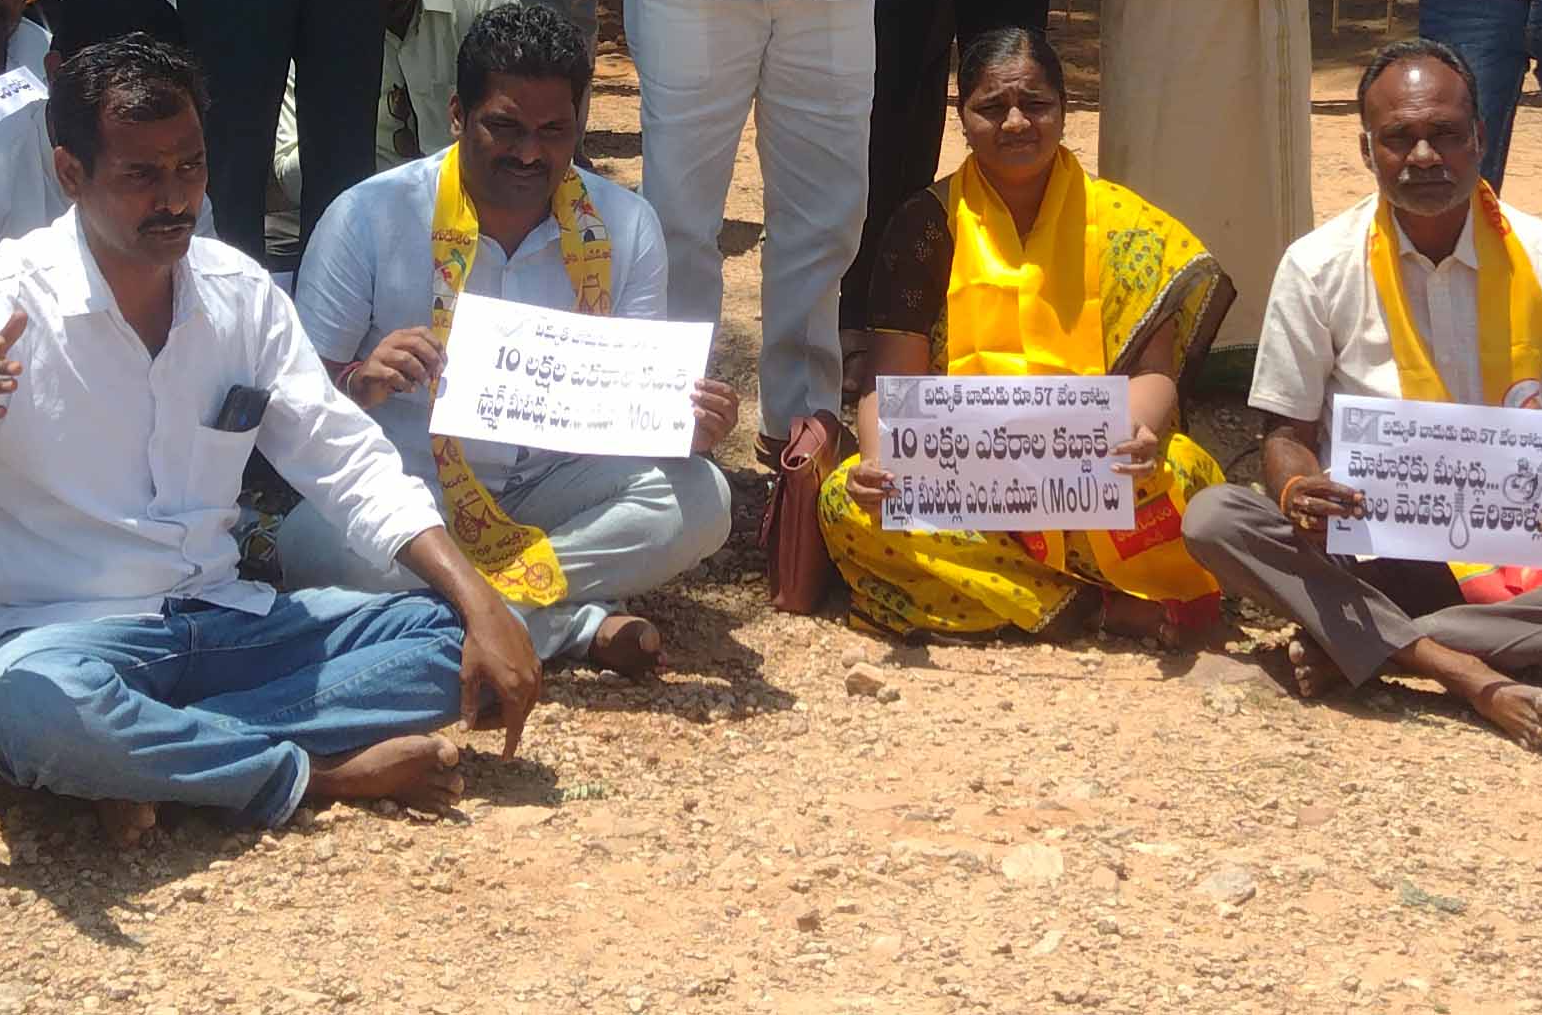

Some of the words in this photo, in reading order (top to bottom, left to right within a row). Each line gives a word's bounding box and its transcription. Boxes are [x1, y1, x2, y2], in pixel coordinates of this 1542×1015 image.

[495, 346, 521, 371] 10
[924, 384, 962, 412] విద్యుత్
[1012, 387, 1054, 406] రూ.57
[891, 426, 918, 459] 10
[924, 426, 970, 475] లక్షల
[975, 425, 1047, 460] ఎకరాల
[1052, 421, 1109, 474] కబ్జాకే
[1348, 450, 1428, 488] మోటార్లకు
[918, 475, 963, 522] మీటర్లు
[1041, 475, 1099, 517] (MoU)
[1102, 484, 1120, 512] లు
[1394, 492, 1453, 527] మెడకు
